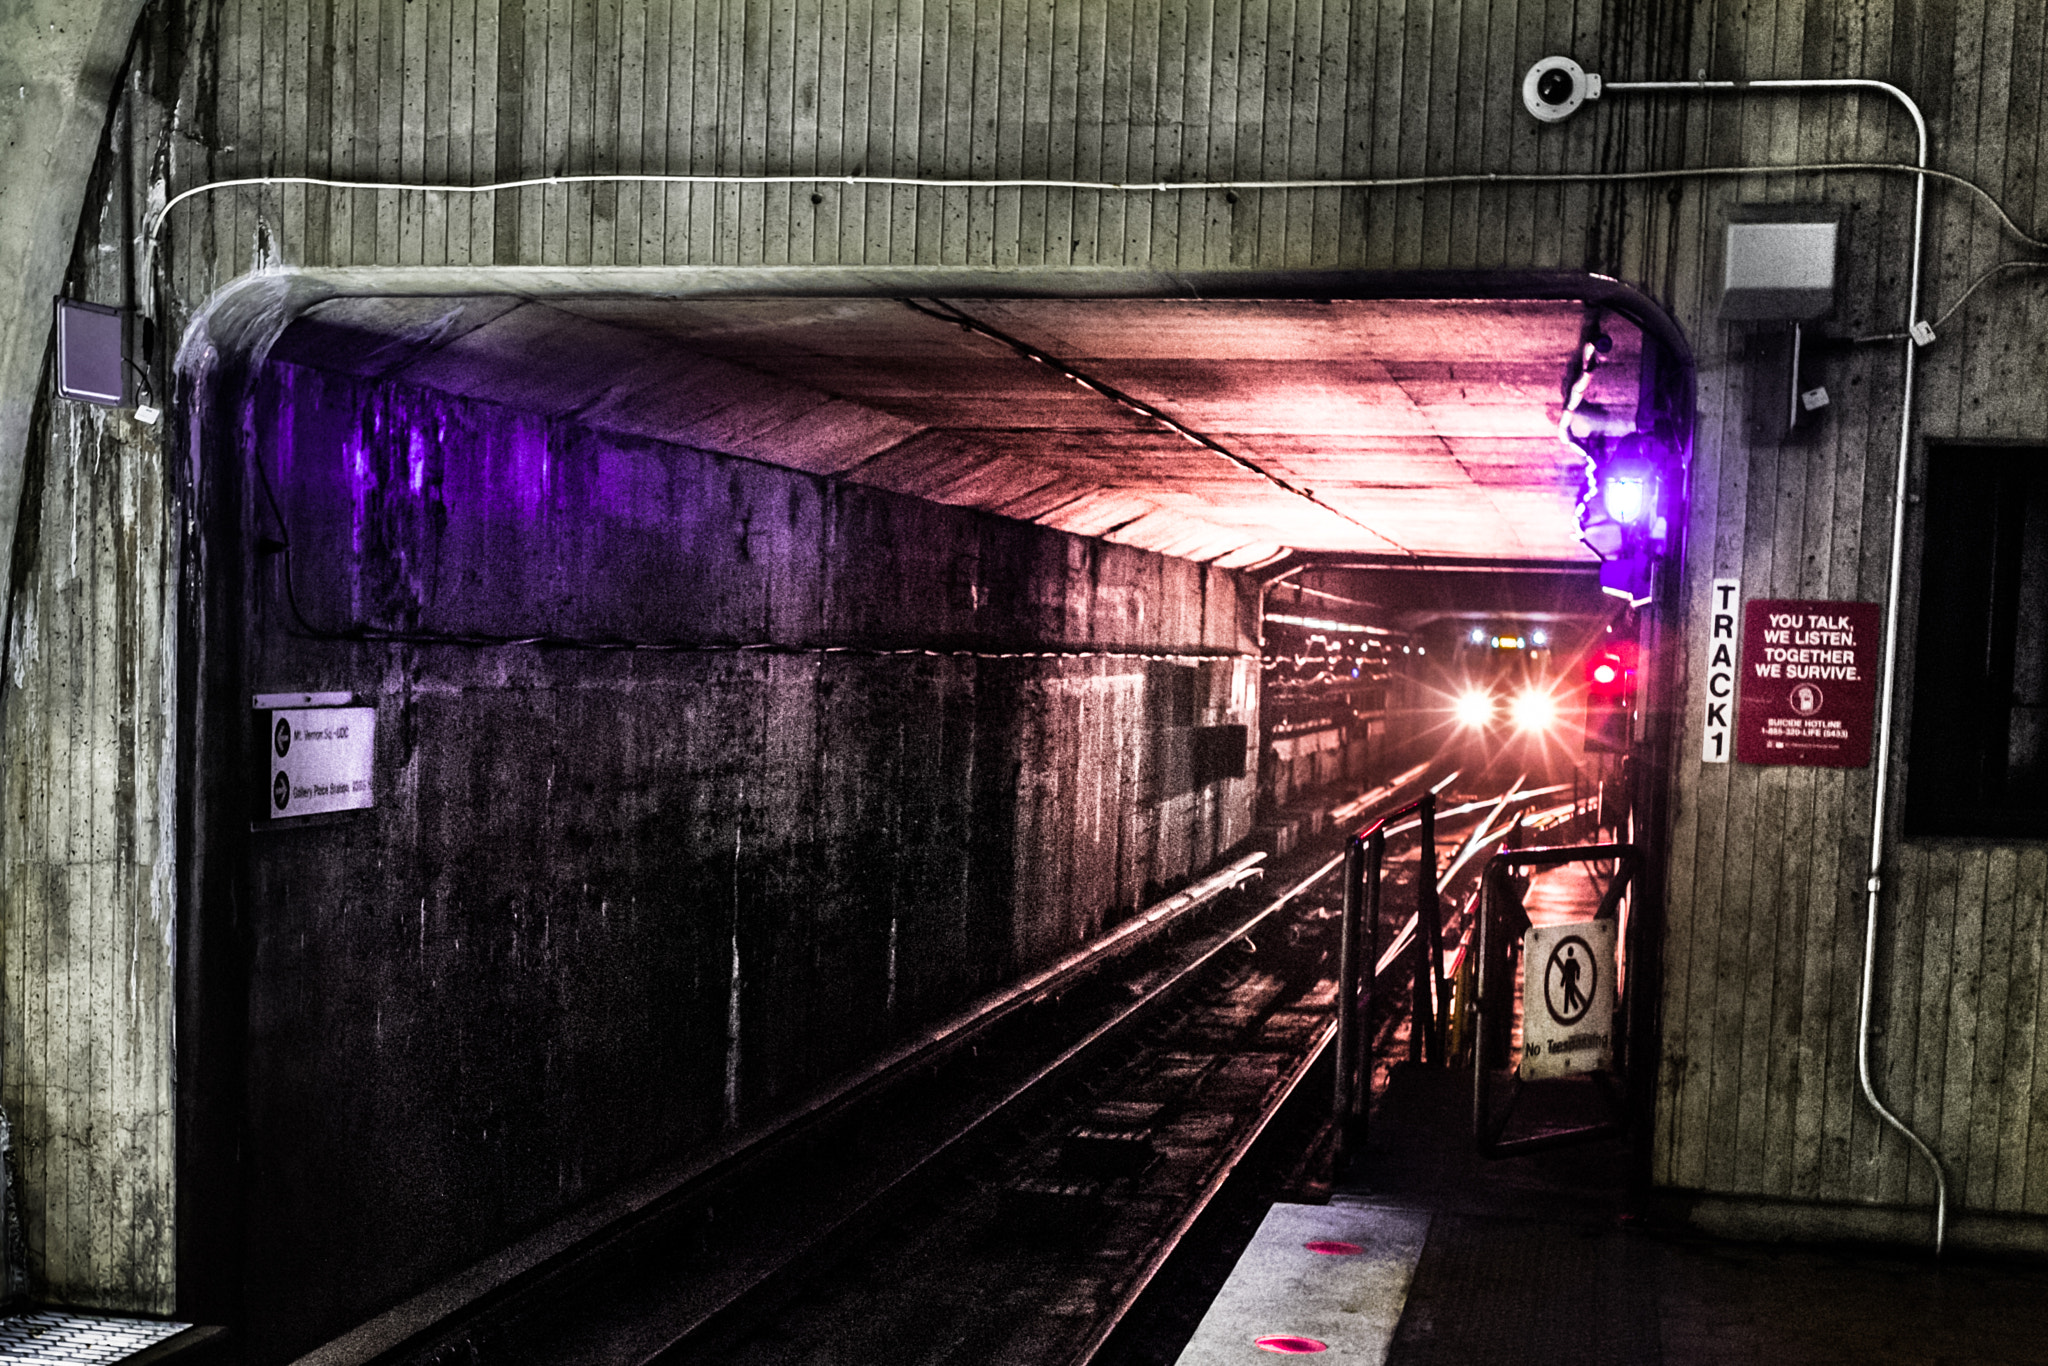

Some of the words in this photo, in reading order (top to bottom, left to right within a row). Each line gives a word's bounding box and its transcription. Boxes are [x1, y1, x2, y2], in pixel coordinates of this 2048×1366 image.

[1769, 614, 1803, 629] YOU
[1808, 615, 1854, 631] TALK,
[1764, 630, 1790, 644] WE
[1795, 630, 1857, 646] LISTEN.
[1707, 585, 1736, 727] TRACK
[1764, 648, 1855, 664] TOGETHER
[1755, 664, 1781, 678] WE
[1786, 665, 1861, 681] SURVIVE.
[1767, 718, 1802, 727] SUICIDE
[1804, 719, 1842, 728] HOTLINE
[1711, 732, 1724, 757] 1
[314, 784, 328, 796] Place
[1525, 1041, 1541, 1058] No
